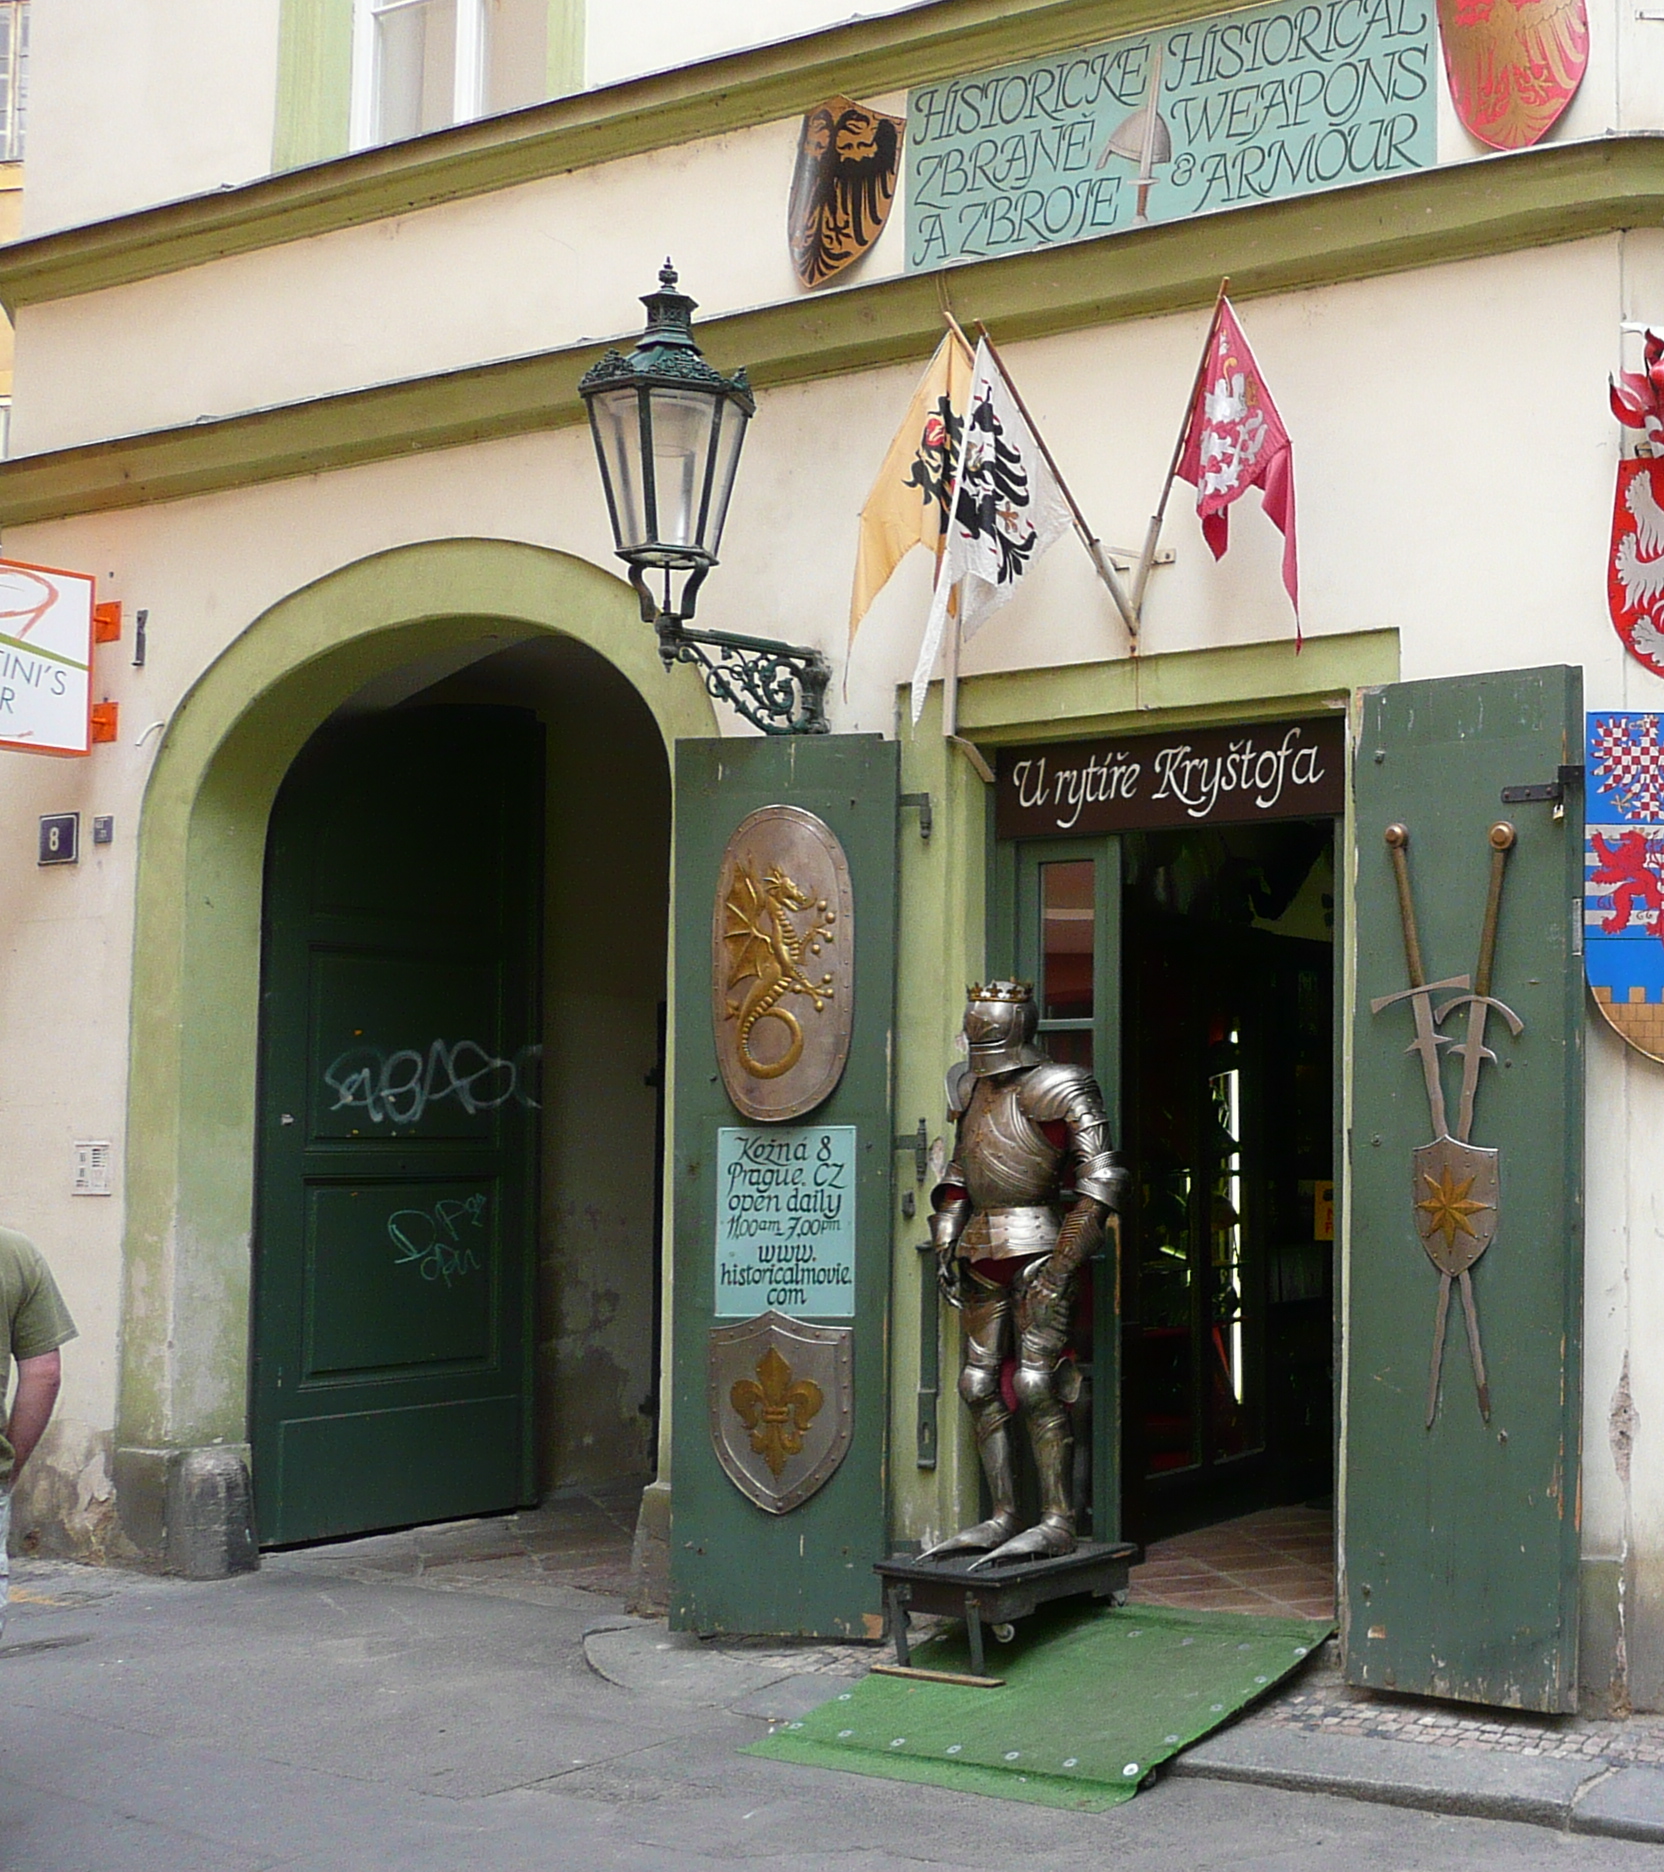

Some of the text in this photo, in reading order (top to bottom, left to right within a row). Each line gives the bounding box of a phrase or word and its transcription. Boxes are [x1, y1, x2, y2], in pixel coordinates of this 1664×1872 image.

[1165, 0, 1427, 92] HISTORICAL
[912, 37, 1150, 145] HISTORICKÉ
[1170, 43, 1429, 146] WEAPONS
[914, 111, 1096, 210] ZBRANĚ
[1171, 113, 1424, 212] & ARMOUR
[912, 176, 1122, 266] A ZBROJE
[0, 650, 67, 696] INI'S
[1013, 727, 1324, 828] U rytíře Kryštofa
[50, 826, 59, 851] 8
[734, 1136, 832, 1166] Kožná 8
[813, 1162, 849, 1189] CZ
[728, 1188, 842, 1220] open daily
[720, 1263, 852, 1286] historicalmovie.
[758, 1244, 817, 1263] www.
[766, 1288, 807, 1305] com
